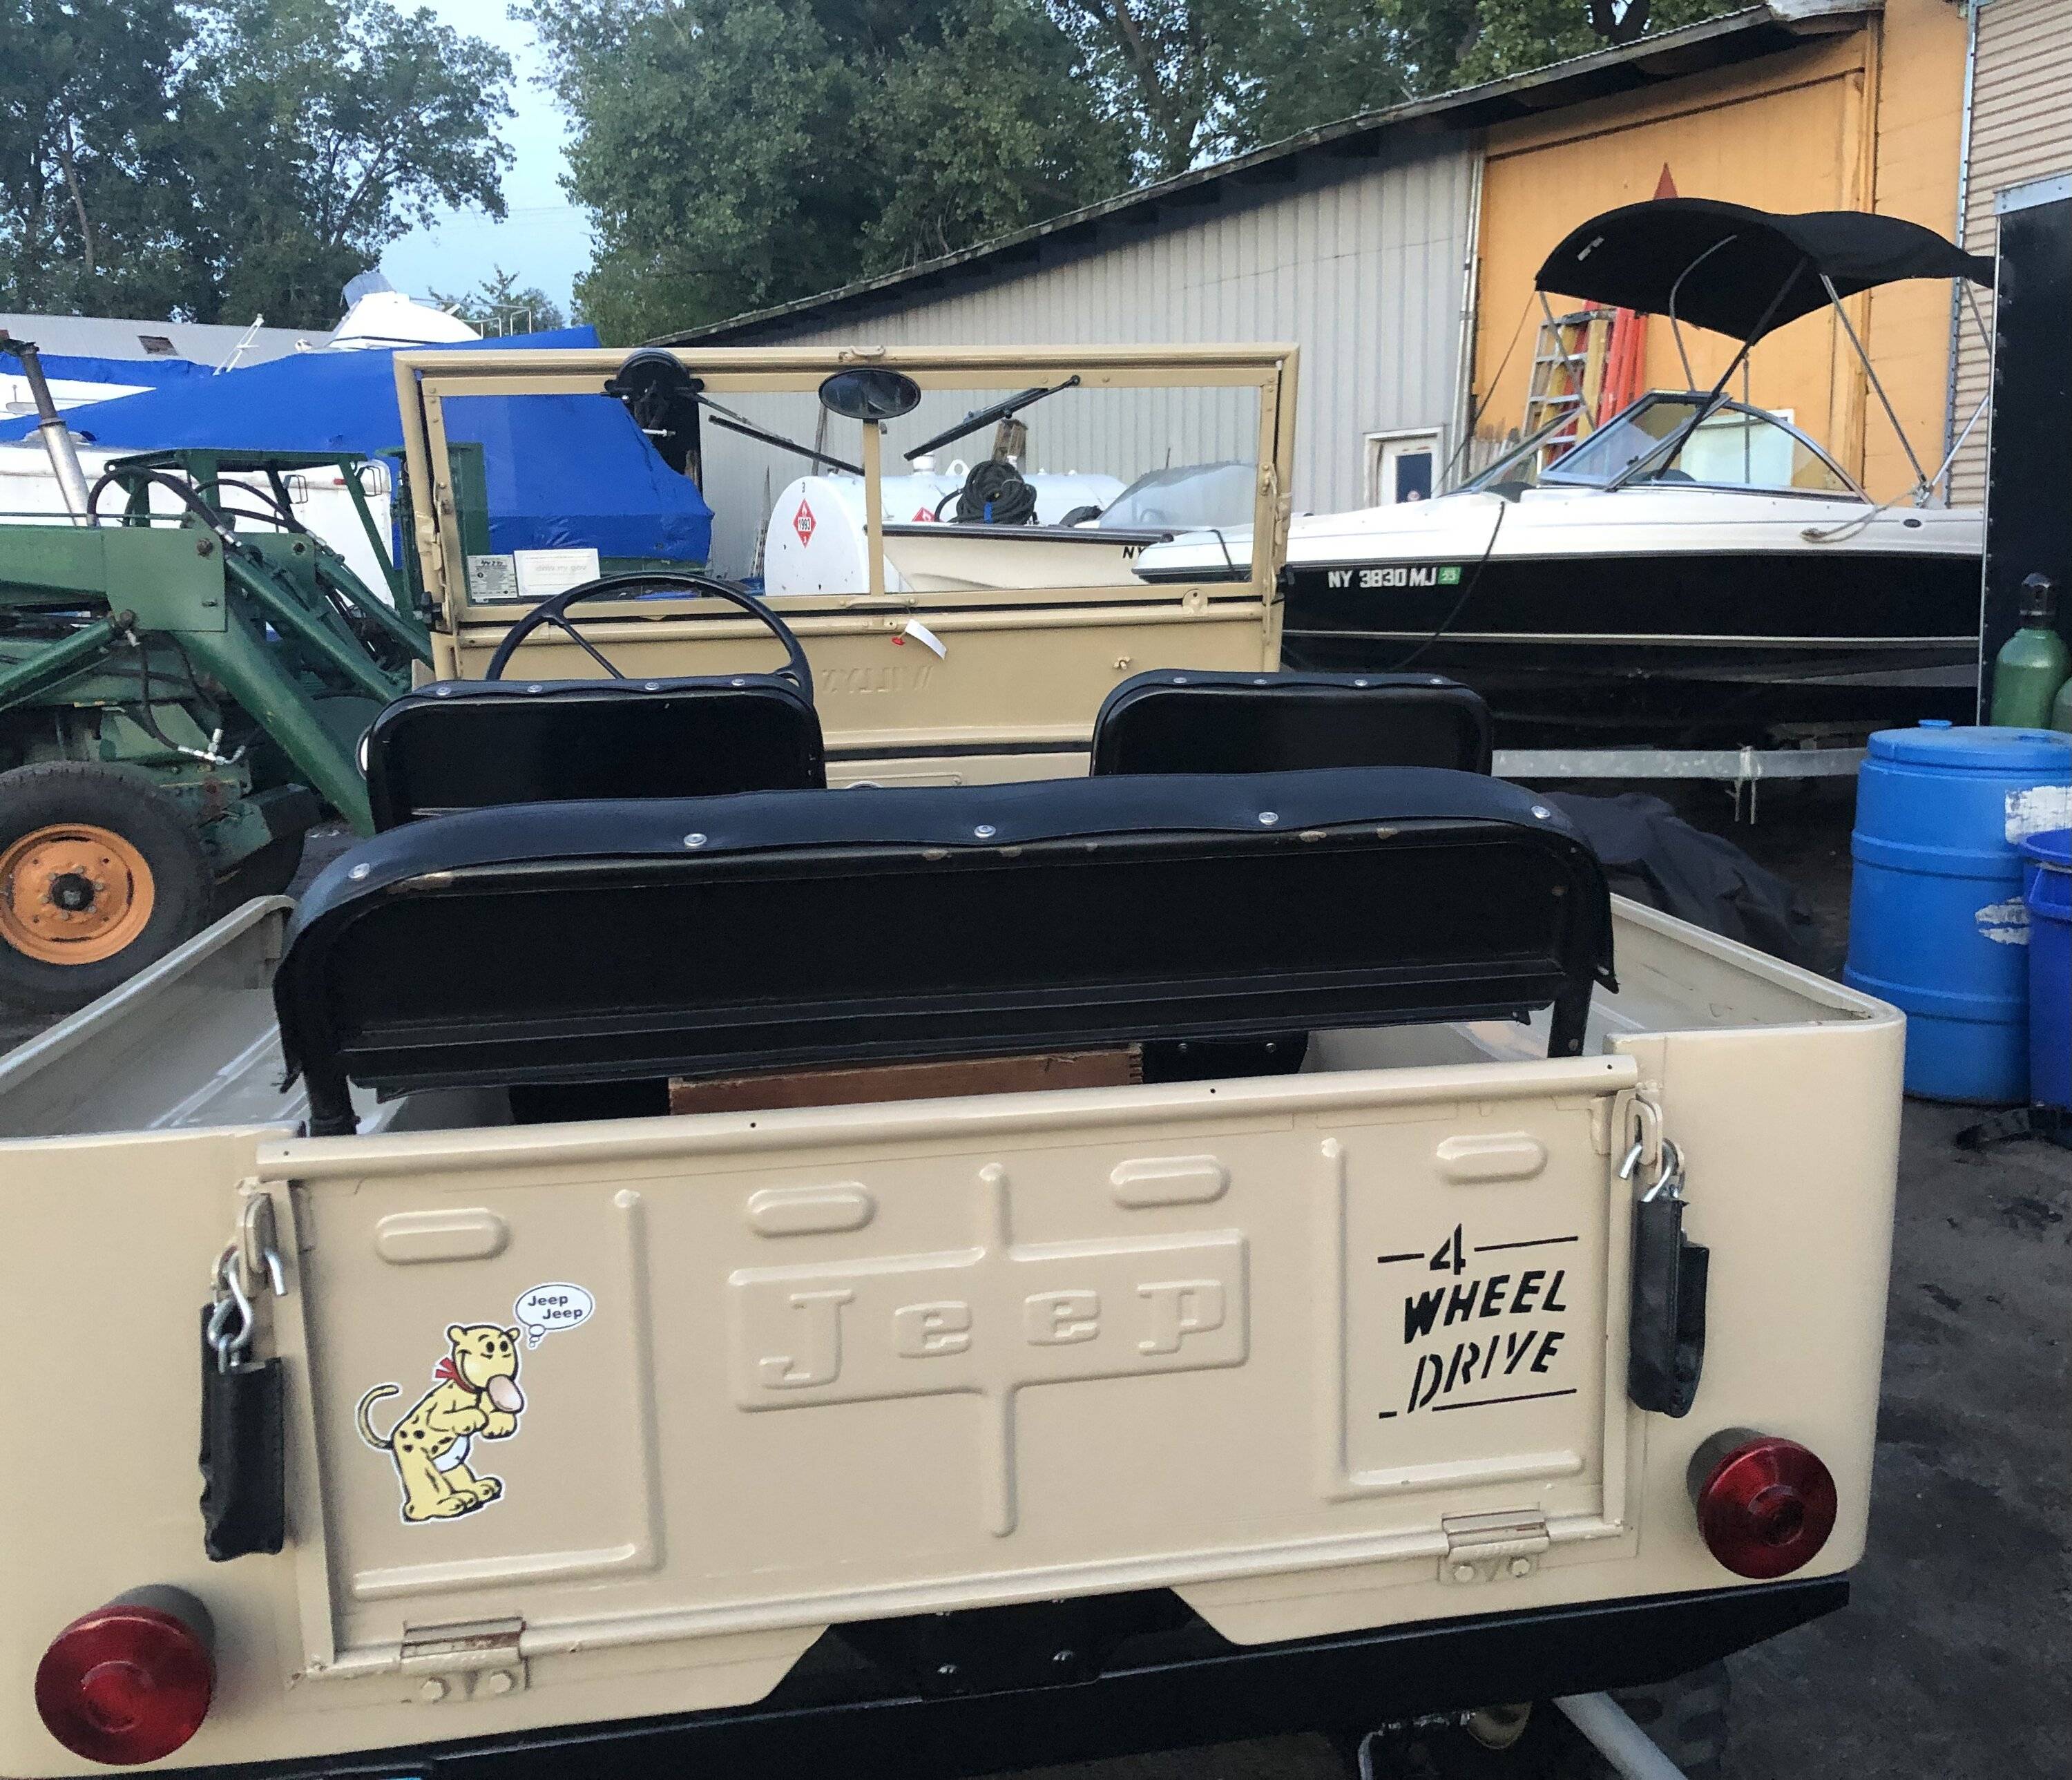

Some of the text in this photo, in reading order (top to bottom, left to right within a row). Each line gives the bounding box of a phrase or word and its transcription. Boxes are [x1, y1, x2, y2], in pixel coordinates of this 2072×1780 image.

[798, 518, 811, 531] 1993
[1327, 567, 1437, 588] NY 3830 MJ
[1430, 1223, 1466, 1275] 4
[528, 1296, 568, 1307] Jeep
[543, 1309, 583, 1319] Jeep
[1404, 1270, 1566, 1344] WHEEL
[760, 1279, 1225, 1388] Jeep
[1407, 1330, 1565, 1414] DRIVE
